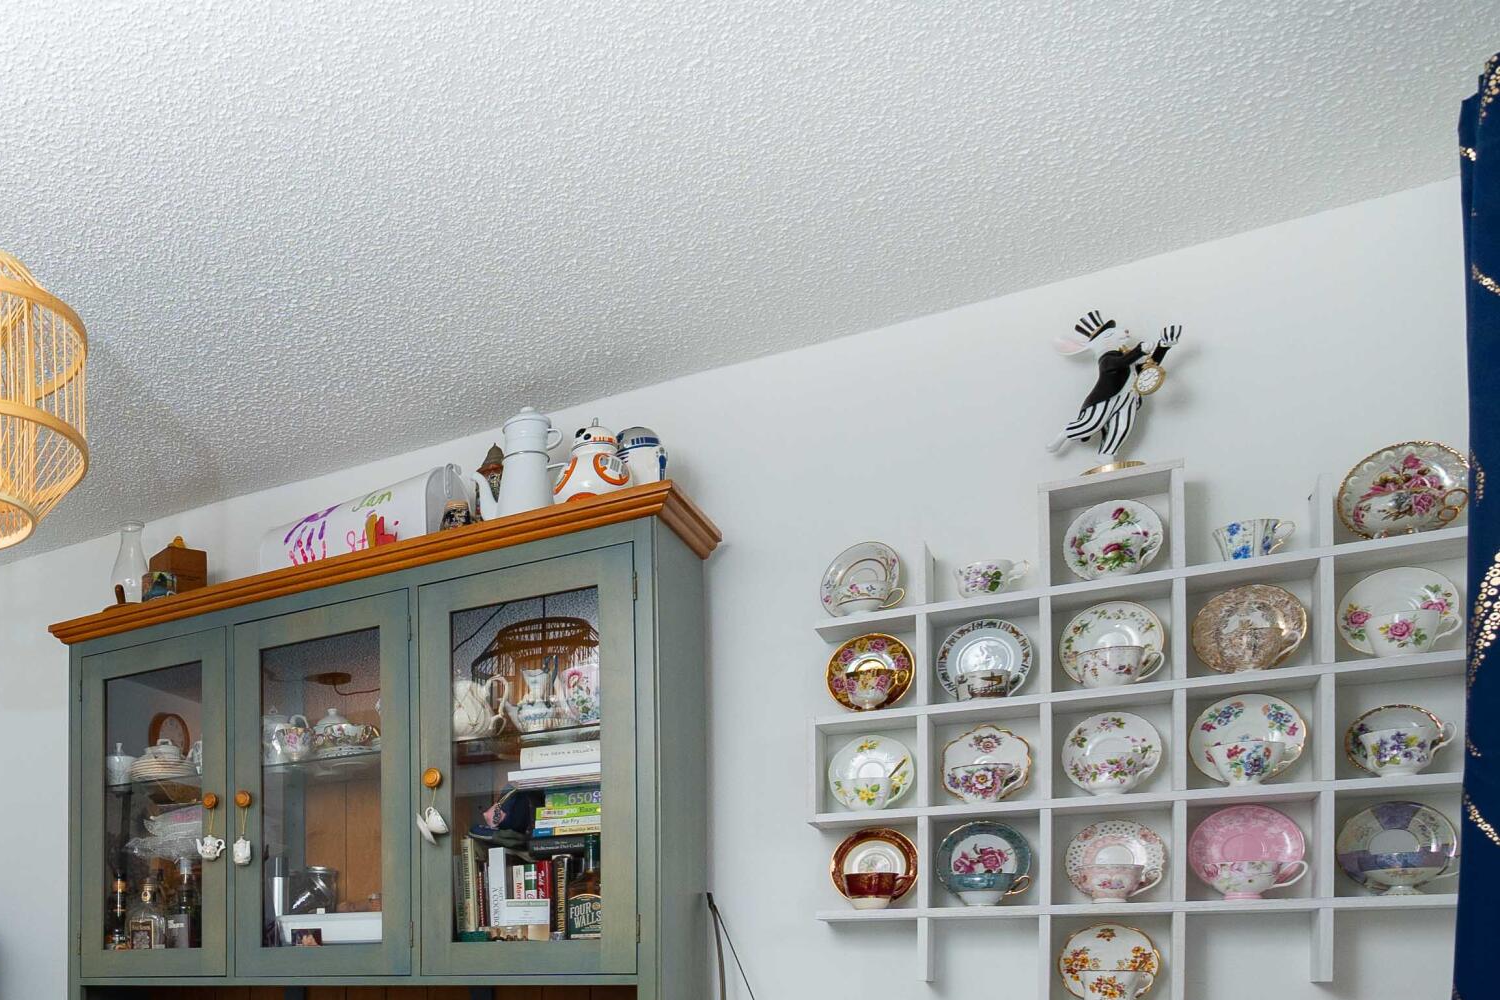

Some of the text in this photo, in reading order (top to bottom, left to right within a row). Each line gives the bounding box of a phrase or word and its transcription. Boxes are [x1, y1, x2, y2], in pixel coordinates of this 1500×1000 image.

[568, 792, 592, 804] 650
[570, 902, 592, 919] FOUR
[574, 910, 601, 928] WALLS
